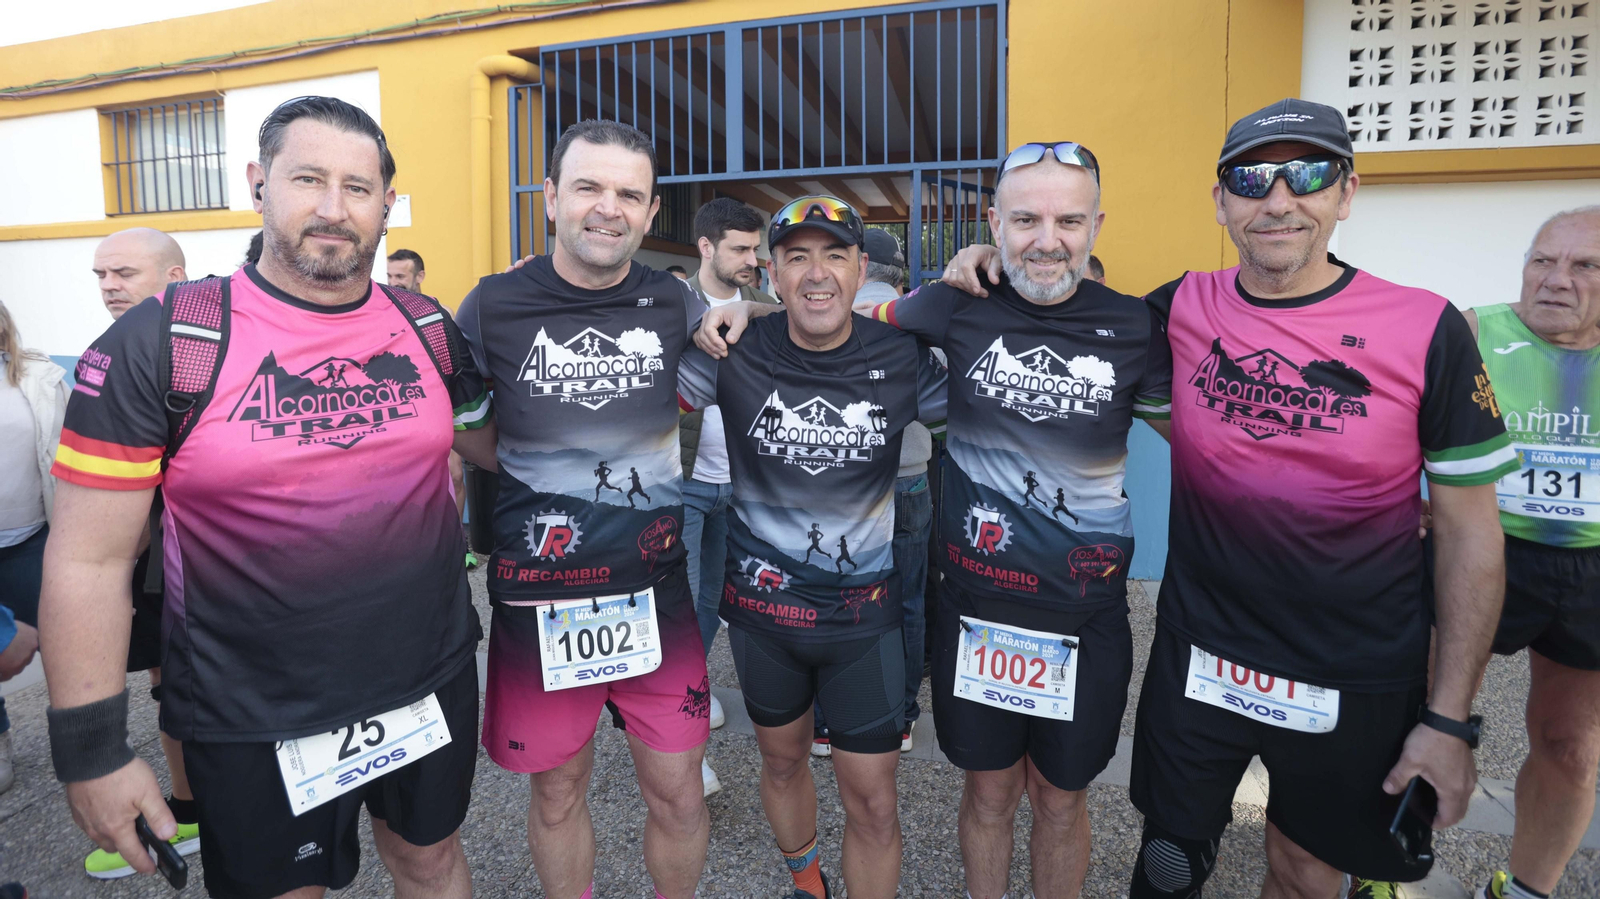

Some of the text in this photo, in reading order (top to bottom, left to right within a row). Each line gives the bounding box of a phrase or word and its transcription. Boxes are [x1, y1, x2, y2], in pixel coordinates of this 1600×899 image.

[535, 376, 651, 395] TRAIL
[560, 392, 629, 403] RUNNING
[980, 384, 1095, 414] TRAIL
[1001, 402, 1069, 419] RUNNING
[1201, 394, 1338, 432] TRAIL
[259, 406, 414, 437] TRAIL
[1220, 416, 1302, 437] RUNNING
[298, 427, 387, 447] RUNNING
[763, 443, 869, 460] TRAIL
[1531, 455, 1587, 466] MARATÓN
[784, 459, 845, 468] RUNNING
[1521, 468, 1581, 498] 131
[1522, 502, 1585, 516] EVOS
[535, 515, 573, 557] TR
[972, 506, 1004, 553] TR
[499, 558, 517, 567] GRUPO
[948, 549, 1039, 586] TU RECAMBIO
[497, 565, 611, 583] TU RECAMBIO
[564, 577, 609, 586] ALGECIRAS
[993, 580, 1038, 594] ALGECIRAS
[575, 605, 620, 622] MARATÓN
[725, 588, 818, 621] TU RECAMBIO
[774, 617, 816, 628] ALGECIRAS
[558, 621, 634, 662] 1002
[642, 641, 648, 649] M
[993, 634, 1039, 652] MARATÓN
[575, 663, 629, 680] EVOS
[974, 645, 1047, 689] 1002
[982, 689, 1036, 709] EVOS
[1222, 692, 1287, 721] EVOS
[1313, 700, 1319, 708] L
[418, 714, 429, 724] XL
[331, 718, 386, 762] 25
[286, 743, 299, 771] JOSE LUIS
[335, 747, 408, 787] EVOS
